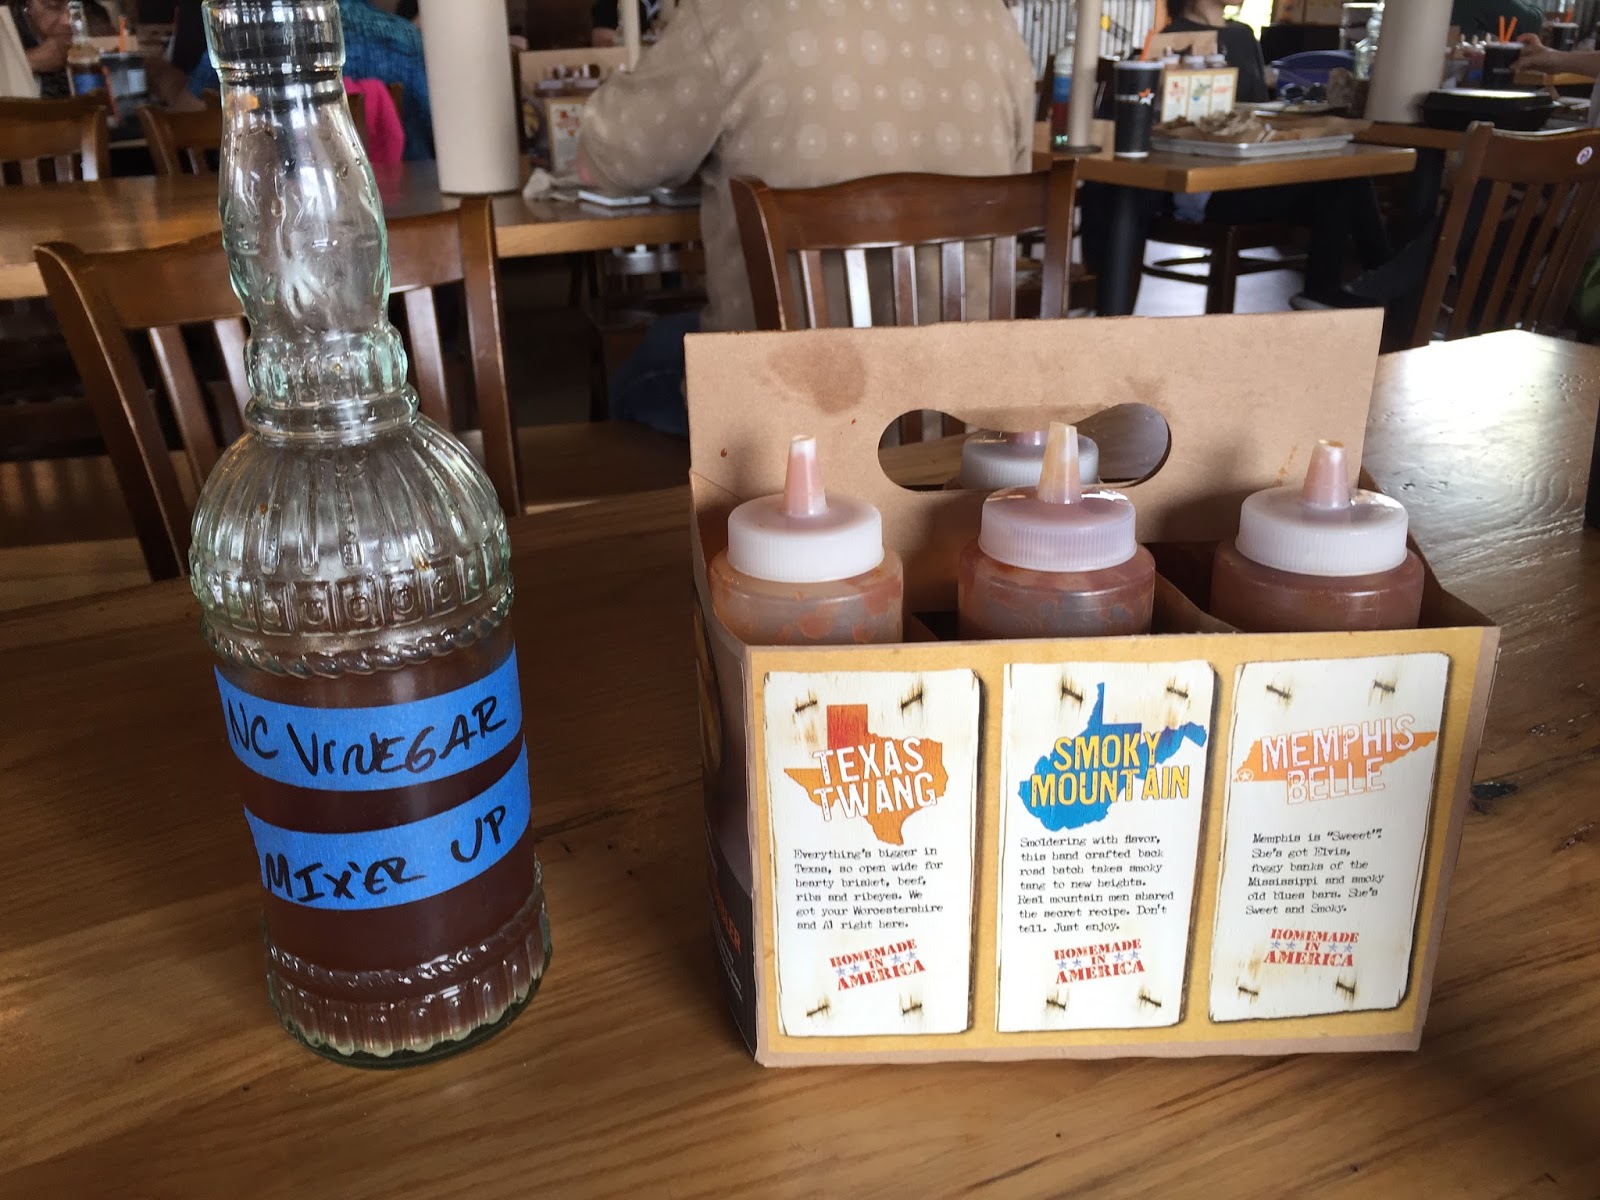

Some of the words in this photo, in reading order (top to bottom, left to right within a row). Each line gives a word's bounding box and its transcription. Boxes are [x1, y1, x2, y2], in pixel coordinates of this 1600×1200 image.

[227, 698, 278, 760] NC
[287, 695, 507, 776] VINEGAR
[1260, 714, 1415, 772] MEMPHIS
[1054, 732, 1161, 771] SMOKY
[812, 737, 923, 784] TEXAS
[1030, 766, 1190, 807] MOUNTAIN
[1287, 757, 1385, 804] BELLE
[813, 772, 937, 822] TWANG
[450, 805, 506, 863] UP
[1253, 832, 1300, 844] Memphis
[1308, 832, 1320, 841] is
[1020, 837, 1086, 847] Smoldering
[1092, 836, 1118, 844] with
[1125, 835, 1161, 844] flavor,
[793, 849, 872, 860] Everything's
[879, 848, 917, 859] bigger
[924, 847, 937, 855] in
[1021, 853, 1046, 861] this
[1052, 851, 1078, 860] hand
[1085, 850, 1130, 859] crafted
[1138, 849, 1164, 858] back
[1252, 848, 1282, 858] She's
[1288, 849, 1308, 858] got
[1314, 847, 1350, 856] Elvis,
[794, 864, 831, 874] Texas,
[859, 865, 886, 874] open
[892, 862, 917, 871] wide
[924, 861, 943, 870] for
[1020, 867, 1045, 876] road
[1052, 866, 1084, 875] batch
[1091, 864, 1122, 873] takes
[1129, 864, 1162, 873] smoky
[1251, 863, 1283, 873] foggy
[1290, 862, 1323, 871] banks
[1330, 861, 1343, 870] of
[1350, 860, 1368, 869] the
[795, 878, 834, 889] hearty
[842, 878, 890, 887] brisket,
[898, 876, 926, 885] beef,
[1020, 882, 1045, 891] tang
[1053, 880, 1064, 889] to
[1071, 880, 1091, 888] new
[1098, 878, 1146, 888] heights.
[1248, 877, 1317, 886] Mississippi
[1325, 876, 1345, 884] and
[1352, 874, 1384, 884] smoky
[796, 893, 821, 901] ribs
[828, 892, 847, 901] and
[854, 892, 902, 902] ribeyes.
[909, 890, 922, 899] We
[1018, 895, 1043, 905] Real
[1050, 894, 1103, 903] mountain
[1135, 892, 1174, 900] shared
[1248, 892, 1266, 901] old
[1273, 891, 1304, 899] blues
[1312, 890, 1341, 898] bars.
[1349, 887, 1378, 898] She's
[796, 907, 815, 916] got
[822, 908, 848, 917] your
[853, 905, 943, 915] Worcestershire
[1019, 910, 1037, 918] the
[1044, 909, 1082, 918] secret
[1088, 908, 1130, 917] recipe.
[1138, 904, 1167, 915] Don't
[1246, 905, 1277, 915] Sweet
[1285, 905, 1304, 913] and
[1311, 904, 1347, 913] Smoky.
[797, 921, 816, 930] and
[841, 920, 872, 930] right
[879, 919, 909, 928] here.
[1018, 924, 1047, 933] tell.
[1054, 923, 1079, 932] Just
[1086, 922, 1120, 932] enjoy.
[1270, 929, 1359, 943] HOMEMADE
[1054, 939, 1142, 960] HOMEMADE
[1305, 942, 1320, 951] IN
[830, 939, 917, 968] HOMEMADE
[1091, 955, 1105, 964] IN
[1264, 950, 1353, 967] AMERICA
[869, 958, 883, 969] IN
[838, 959, 925, 991] AMERICA
[1056, 960, 1145, 984] AMERICA
